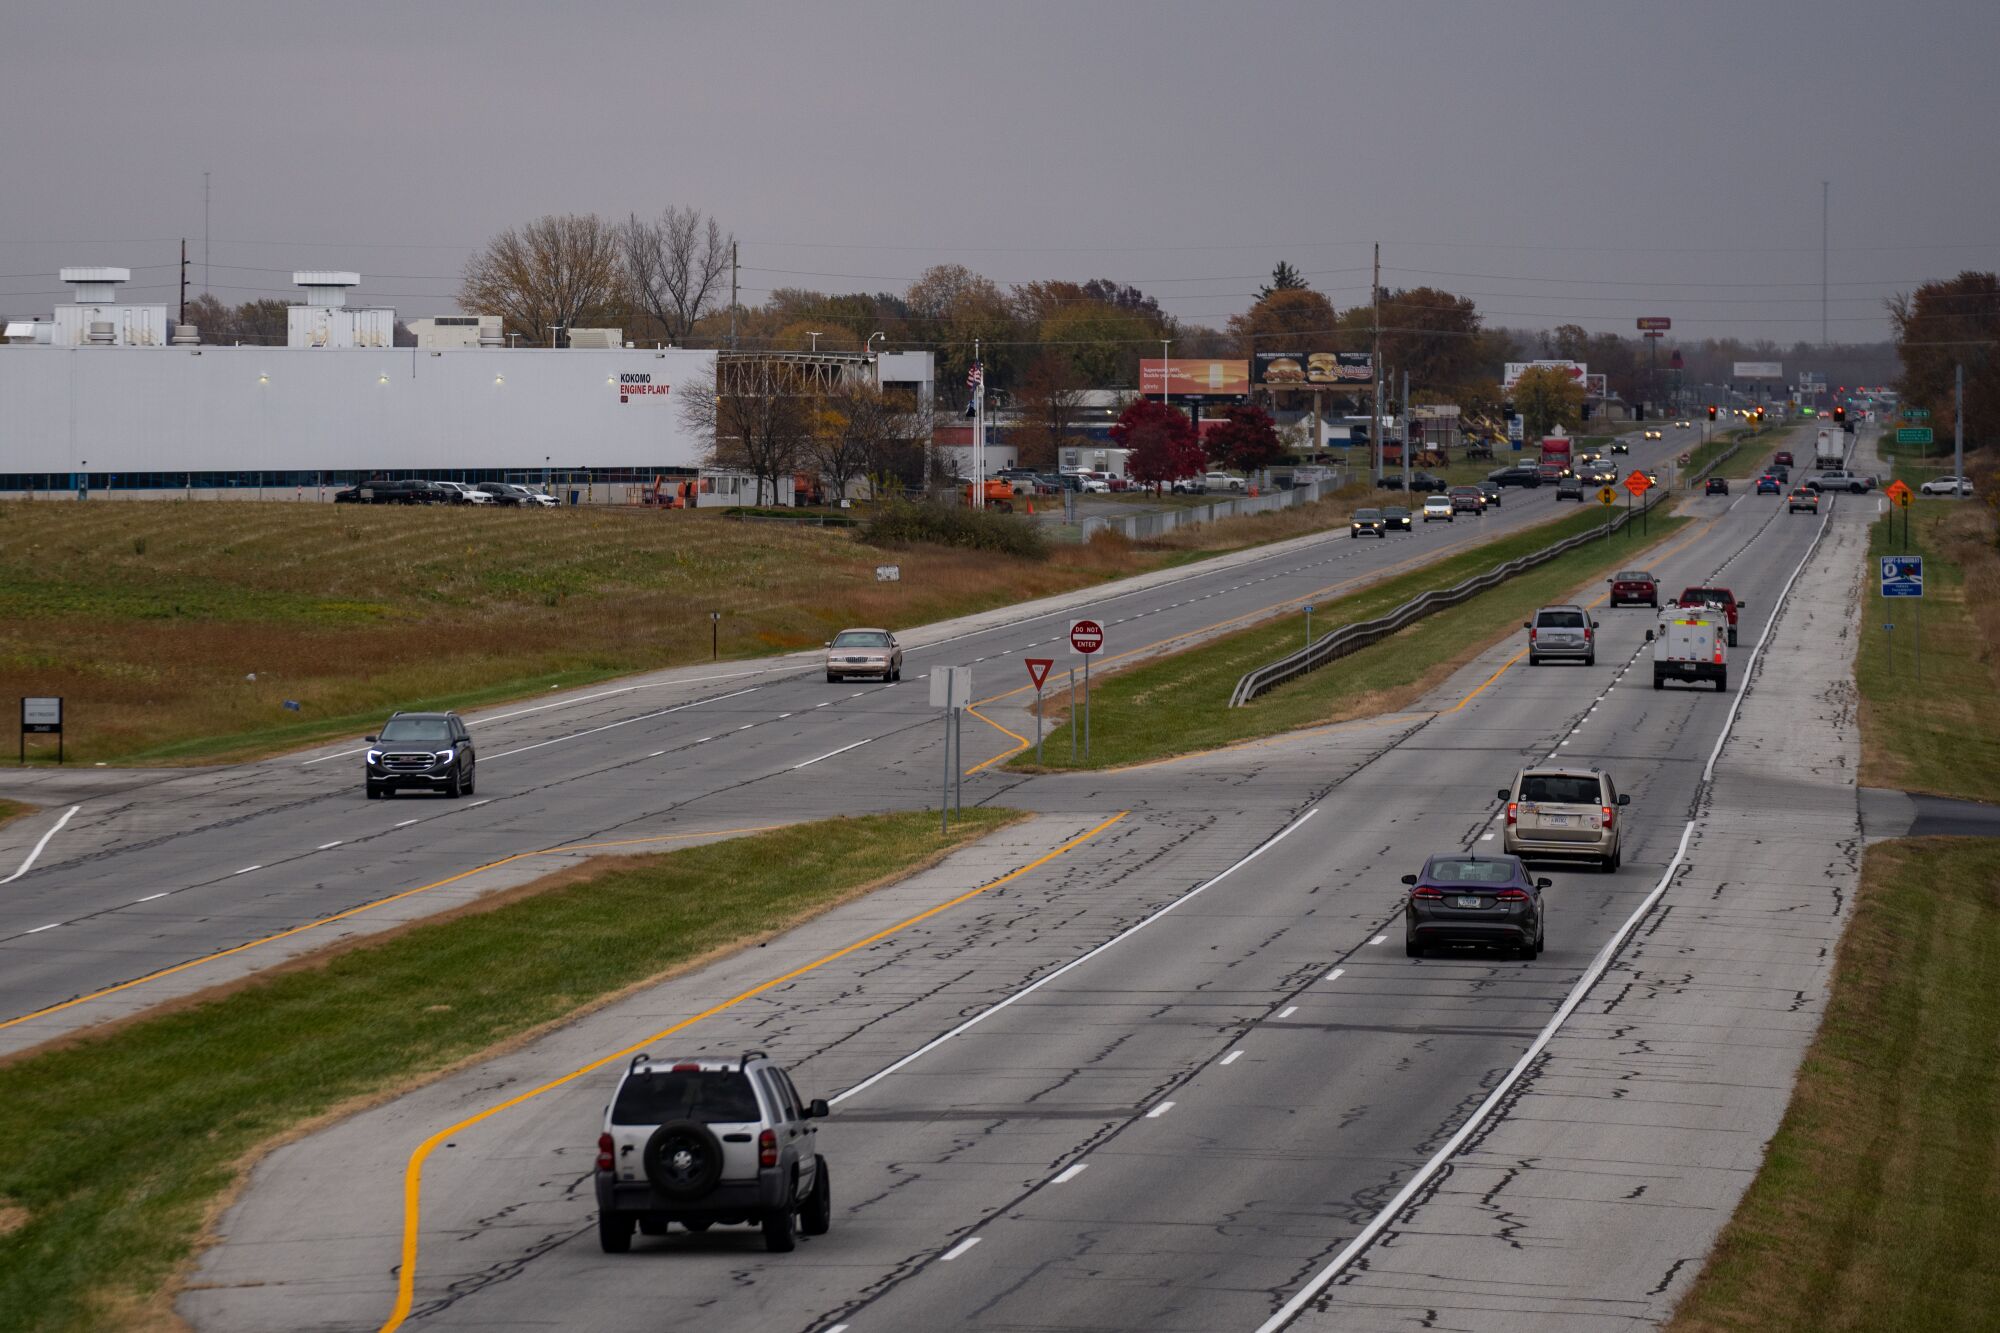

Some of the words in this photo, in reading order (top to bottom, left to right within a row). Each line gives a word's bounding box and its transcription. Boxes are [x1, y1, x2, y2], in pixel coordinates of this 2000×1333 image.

[620, 373, 651, 383] KOKOMO
[620, 385, 647, 394] ENGINE
[648, 385, 670, 394] PLANT
